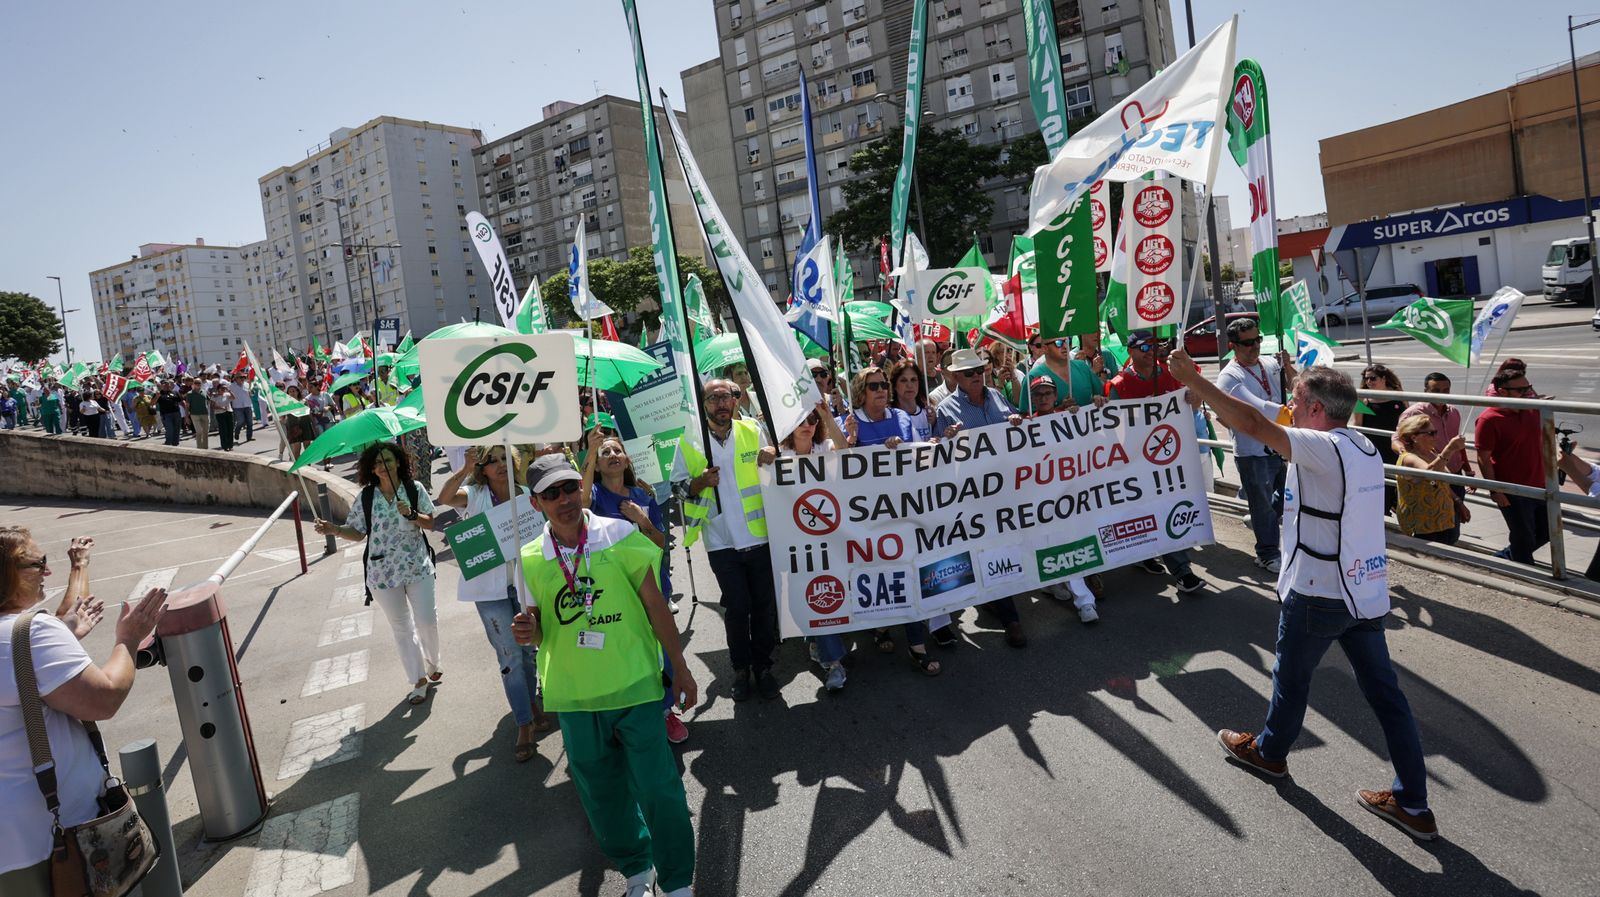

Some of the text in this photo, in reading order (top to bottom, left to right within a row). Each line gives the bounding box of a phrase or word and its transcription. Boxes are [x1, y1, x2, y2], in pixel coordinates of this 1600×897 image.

[1141, 189, 1165, 201] UGT
[1374, 219, 1433, 240] SUPER
[1142, 238, 1166, 250] UGT
[1056, 234, 1076, 332] CSIF
[1143, 285, 1166, 296] UGT
[775, 395, 1181, 487] EN DEFENSA DE NUESTRA
[849, 442, 1129, 522] SANIDAD PÚBLICA
[846, 533, 904, 563] NO
[915, 512, 986, 554] MÁS
[996, 476, 1143, 533] RECORTES
[1116, 518, 1155, 536] CCOO
[1172, 510, 1200, 527] CSIF
[455, 523, 486, 544] SATSE
[465, 548, 497, 568] SATSE
[1042, 544, 1098, 574] SATSE
[813, 581, 838, 594] UGT
